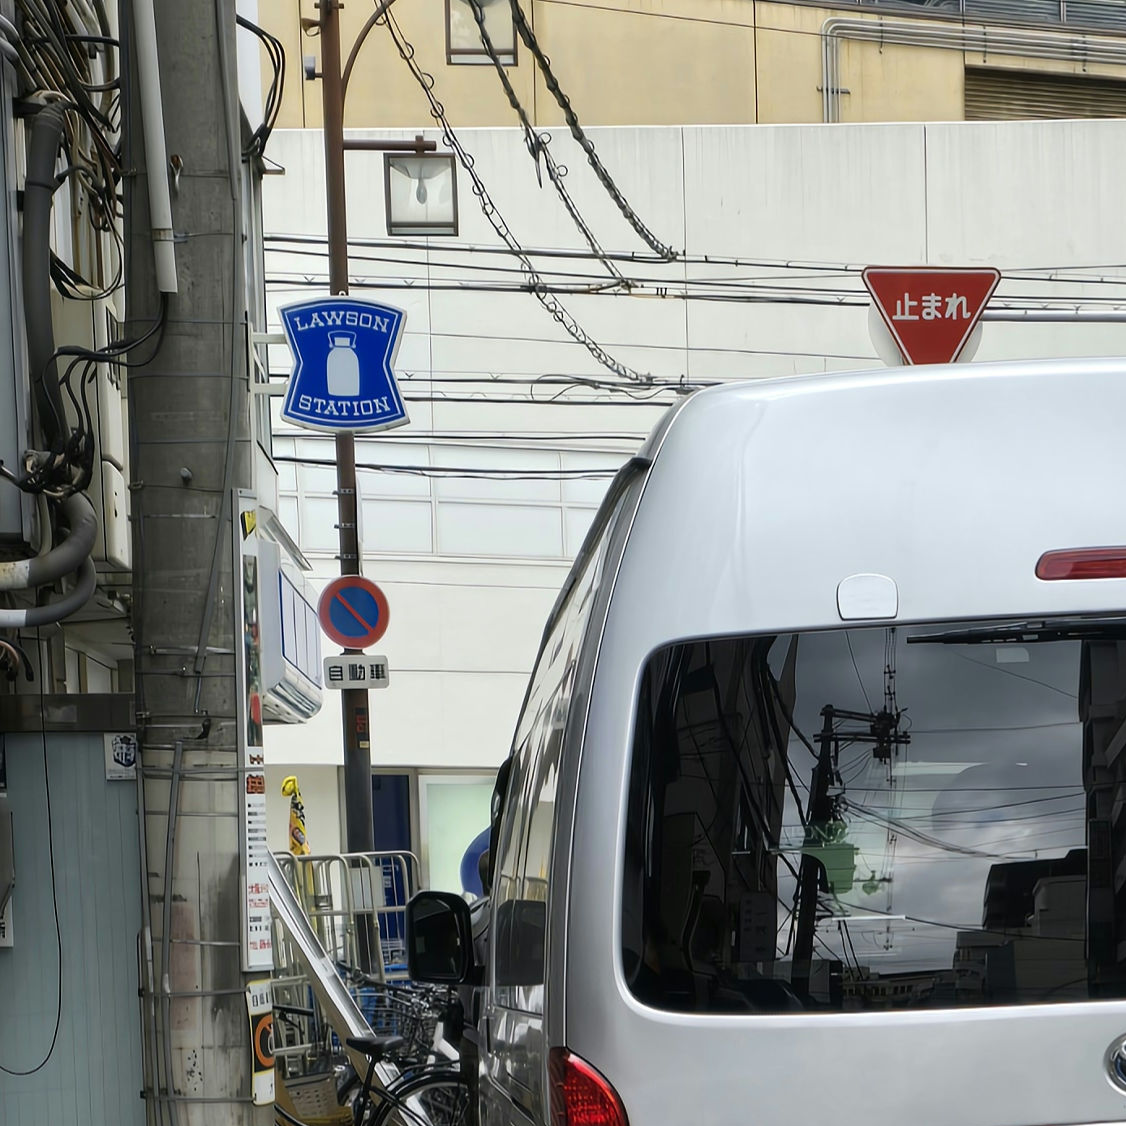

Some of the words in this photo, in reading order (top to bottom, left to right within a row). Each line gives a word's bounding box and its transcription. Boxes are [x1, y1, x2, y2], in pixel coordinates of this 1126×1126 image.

[892, 293, 972, 320] 止まれ
[294, 311, 390, 333] LAWSON
[298, 394, 391, 416] STATION
